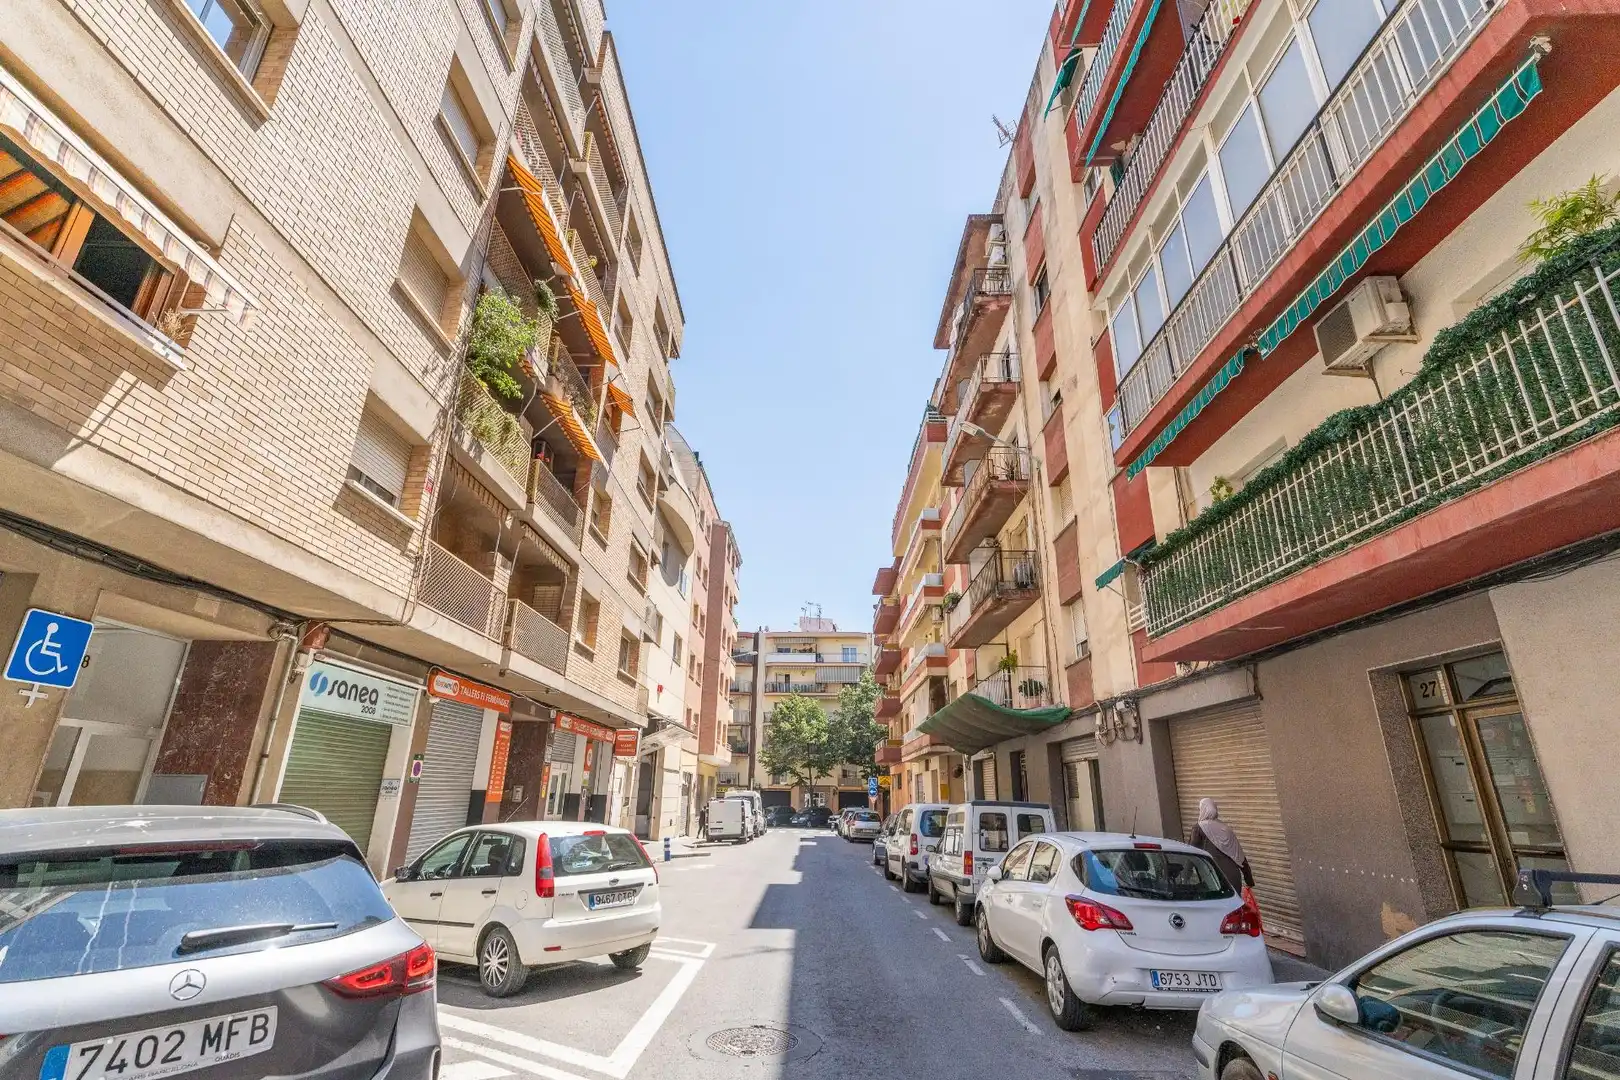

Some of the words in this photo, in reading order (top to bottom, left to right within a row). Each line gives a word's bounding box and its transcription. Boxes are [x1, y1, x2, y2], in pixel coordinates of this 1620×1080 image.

[328, 680, 379, 705] sanea
[460, 686, 481, 700] TALLERS
[1420, 681, 1436, 698] 27
[361, 705, 376, 715] 2008
[596, 894, 615, 905] 9467
[1160, 973, 1190, 985] 6753
[1195, 974, 1217, 986] JTD
[77, 1030, 185, 1080] 7402
[200, 1013, 269, 1056] MFB
